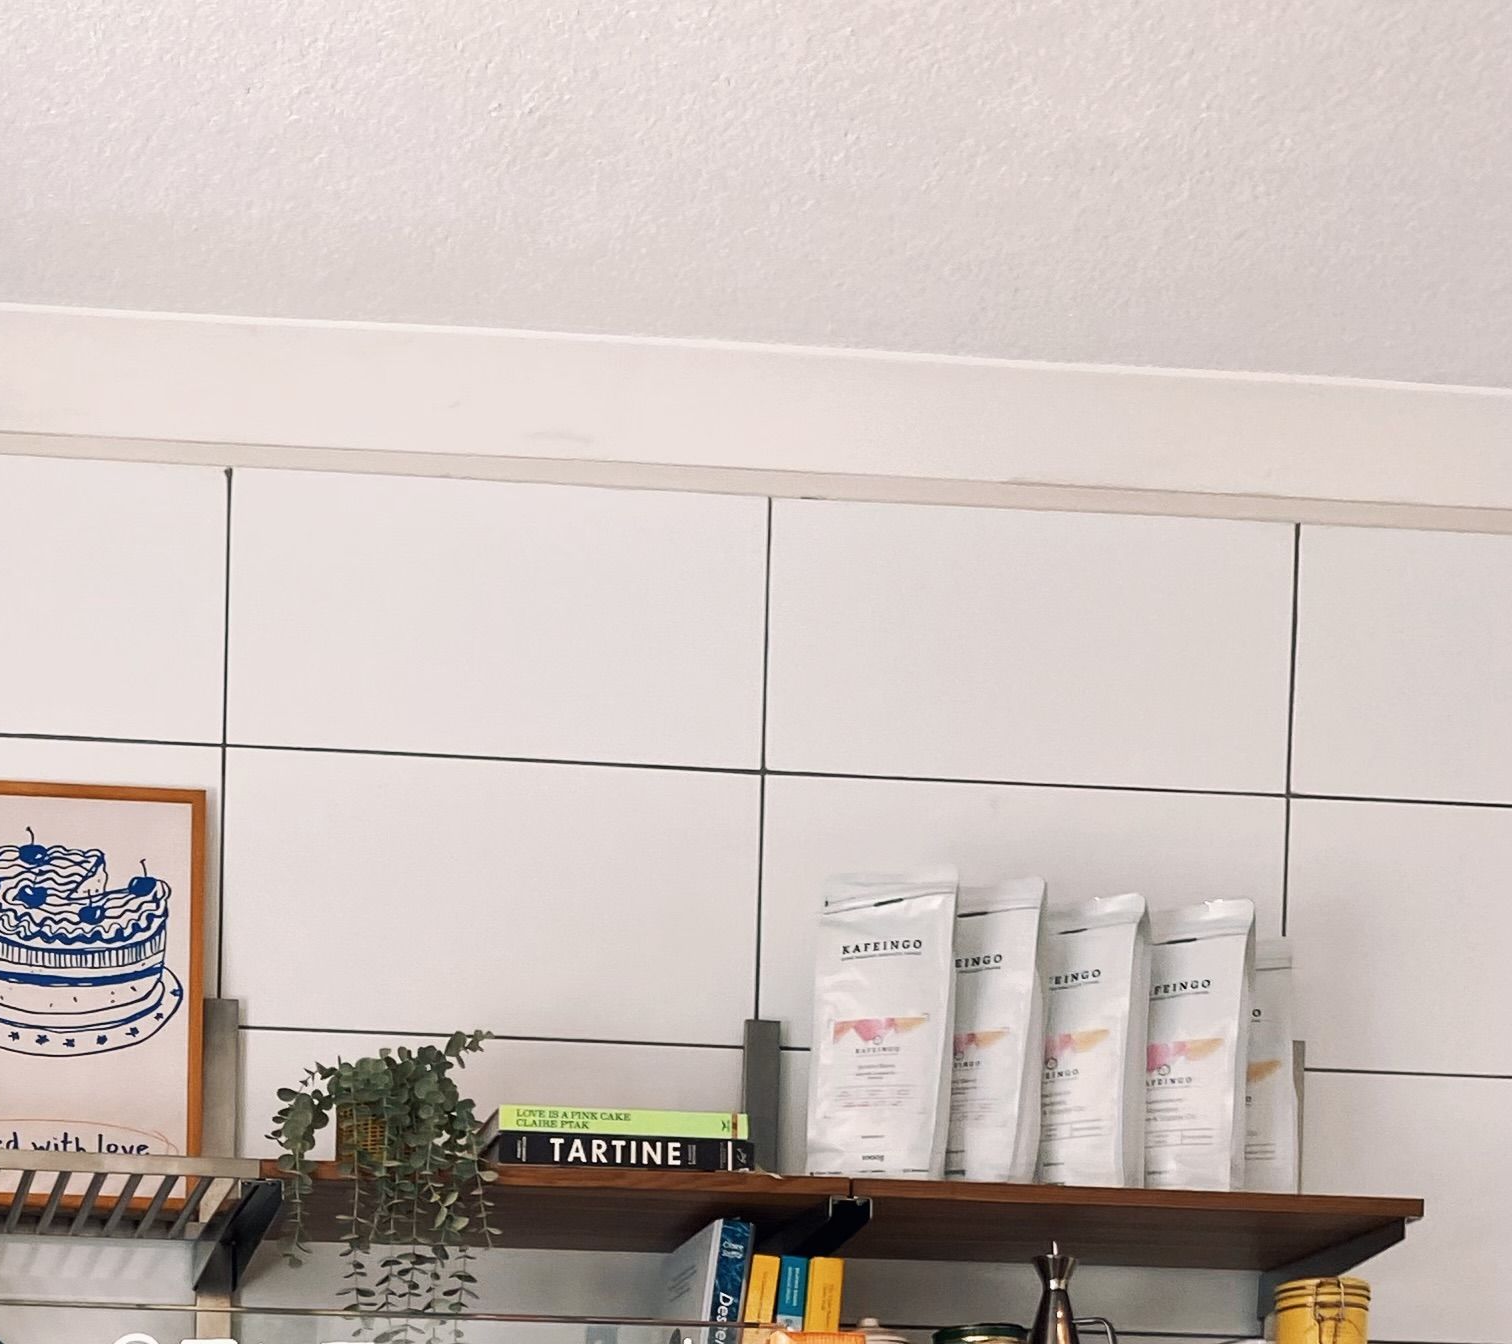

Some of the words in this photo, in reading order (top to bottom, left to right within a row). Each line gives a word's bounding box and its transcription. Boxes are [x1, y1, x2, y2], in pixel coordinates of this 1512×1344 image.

[842, 939, 923, 955] KAFEINGO
[516, 1109, 546, 1119] LOVE
[548, 1110, 559, 1119] IS
[561, 1110, 570, 1119] A
[571, 1111, 598, 1121] PINK
[600, 1112, 632, 1121] CAKE
[516, 1118, 558, 1129] CLAIRE
[560, 1119, 591, 1130] PTAK
[31, 1132, 87, 1153] with
[97, 1134, 151, 1156] love
[549, 1138, 681, 1167] TARTINE
